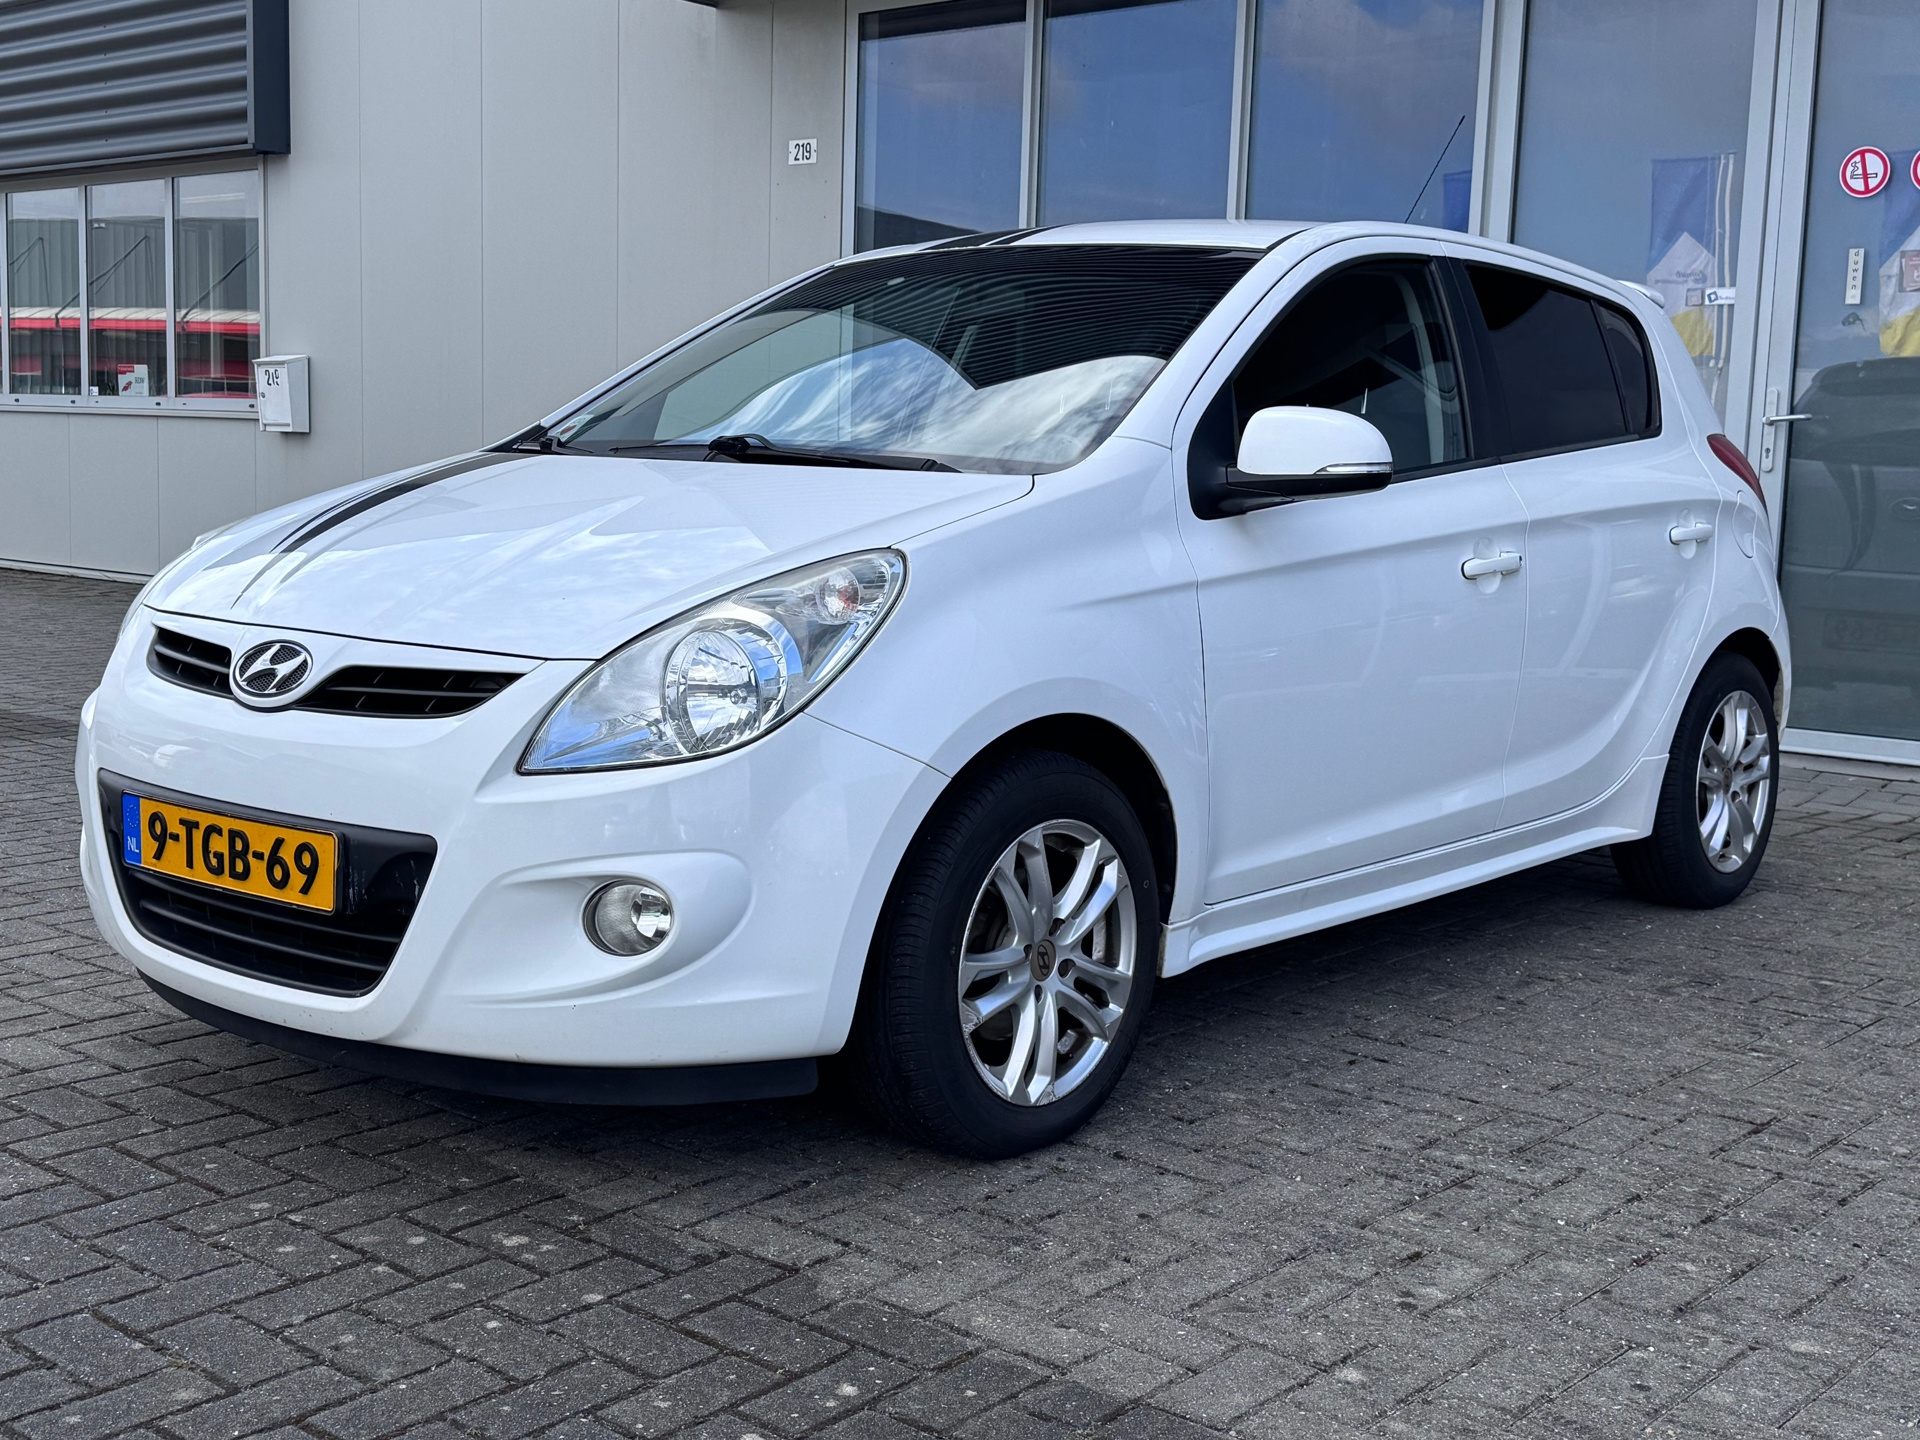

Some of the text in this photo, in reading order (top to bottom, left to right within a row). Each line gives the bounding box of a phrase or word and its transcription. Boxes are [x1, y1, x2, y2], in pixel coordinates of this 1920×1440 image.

[793, 141, 812, 162] 219
[127, 835, 139, 853] NL
[147, 810, 319, 895] 9-TGB-69
